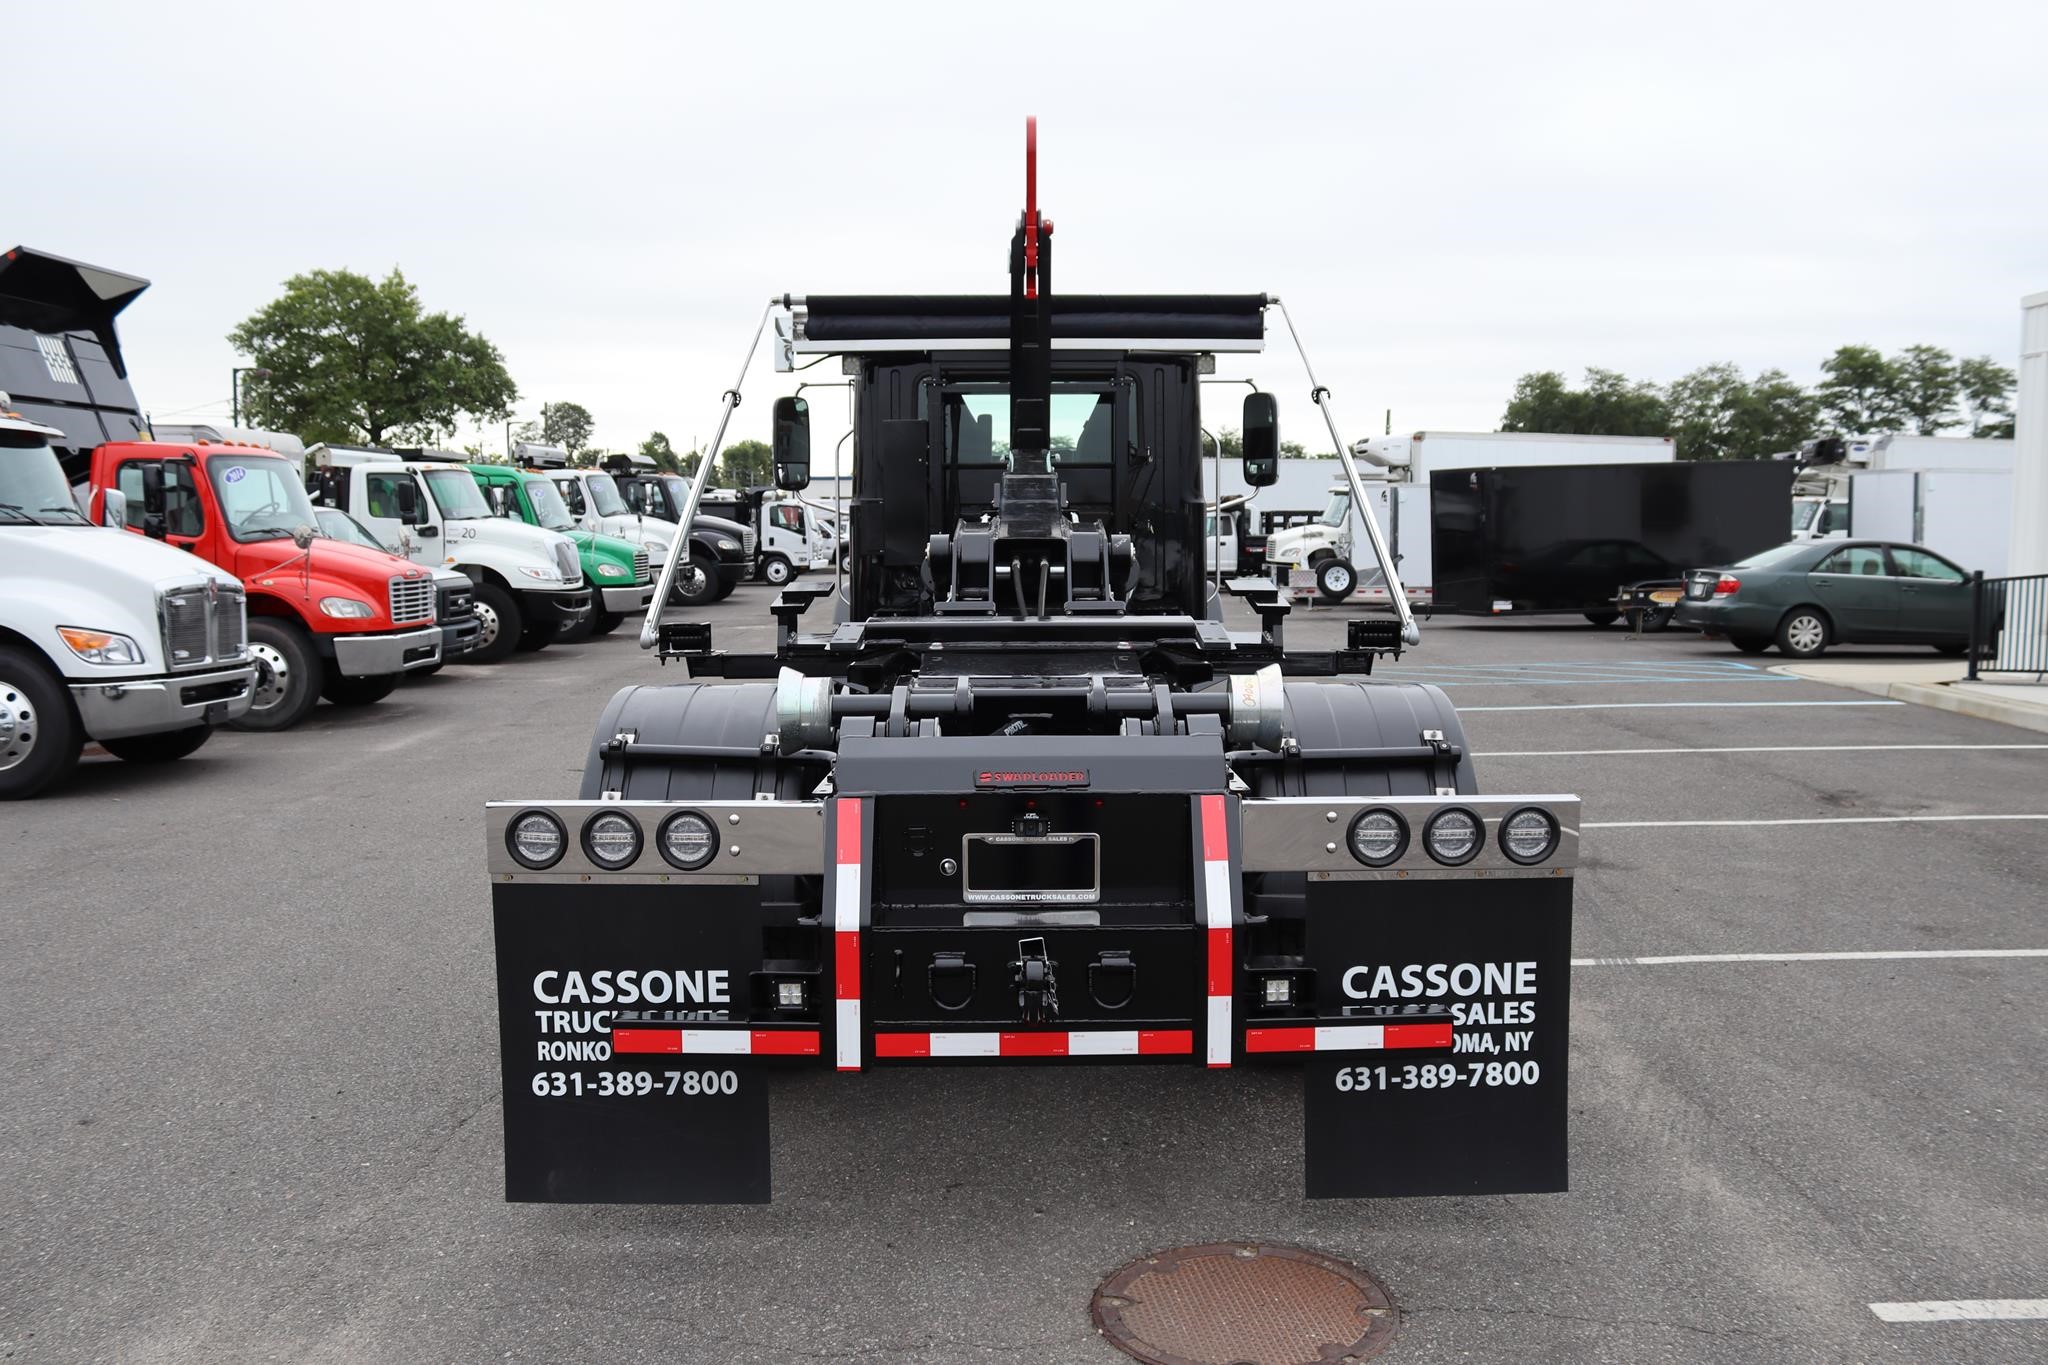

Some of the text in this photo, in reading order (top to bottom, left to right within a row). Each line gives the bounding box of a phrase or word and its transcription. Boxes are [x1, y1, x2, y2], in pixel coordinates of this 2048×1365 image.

[462, 527, 477, 539] 20
[994, 771, 1085, 782] SWAPLOADER
[968, 893, 1096, 901] WWW.CASSONETRUCKSALES.COM
[533, 970, 730, 1003] CASSONE
[1342, 961, 1537, 998] CASSONE
[535, 1010, 618, 1033] TRUC
[1452, 1001, 1536, 1026] SALES
[537, 1040, 611, 1061] RONKO
[1453, 1031, 1534, 1055] OMA, NY
[532, 1070, 738, 1096] 631-389-7800
[1335, 1060, 1540, 1092] 631-389-7800
